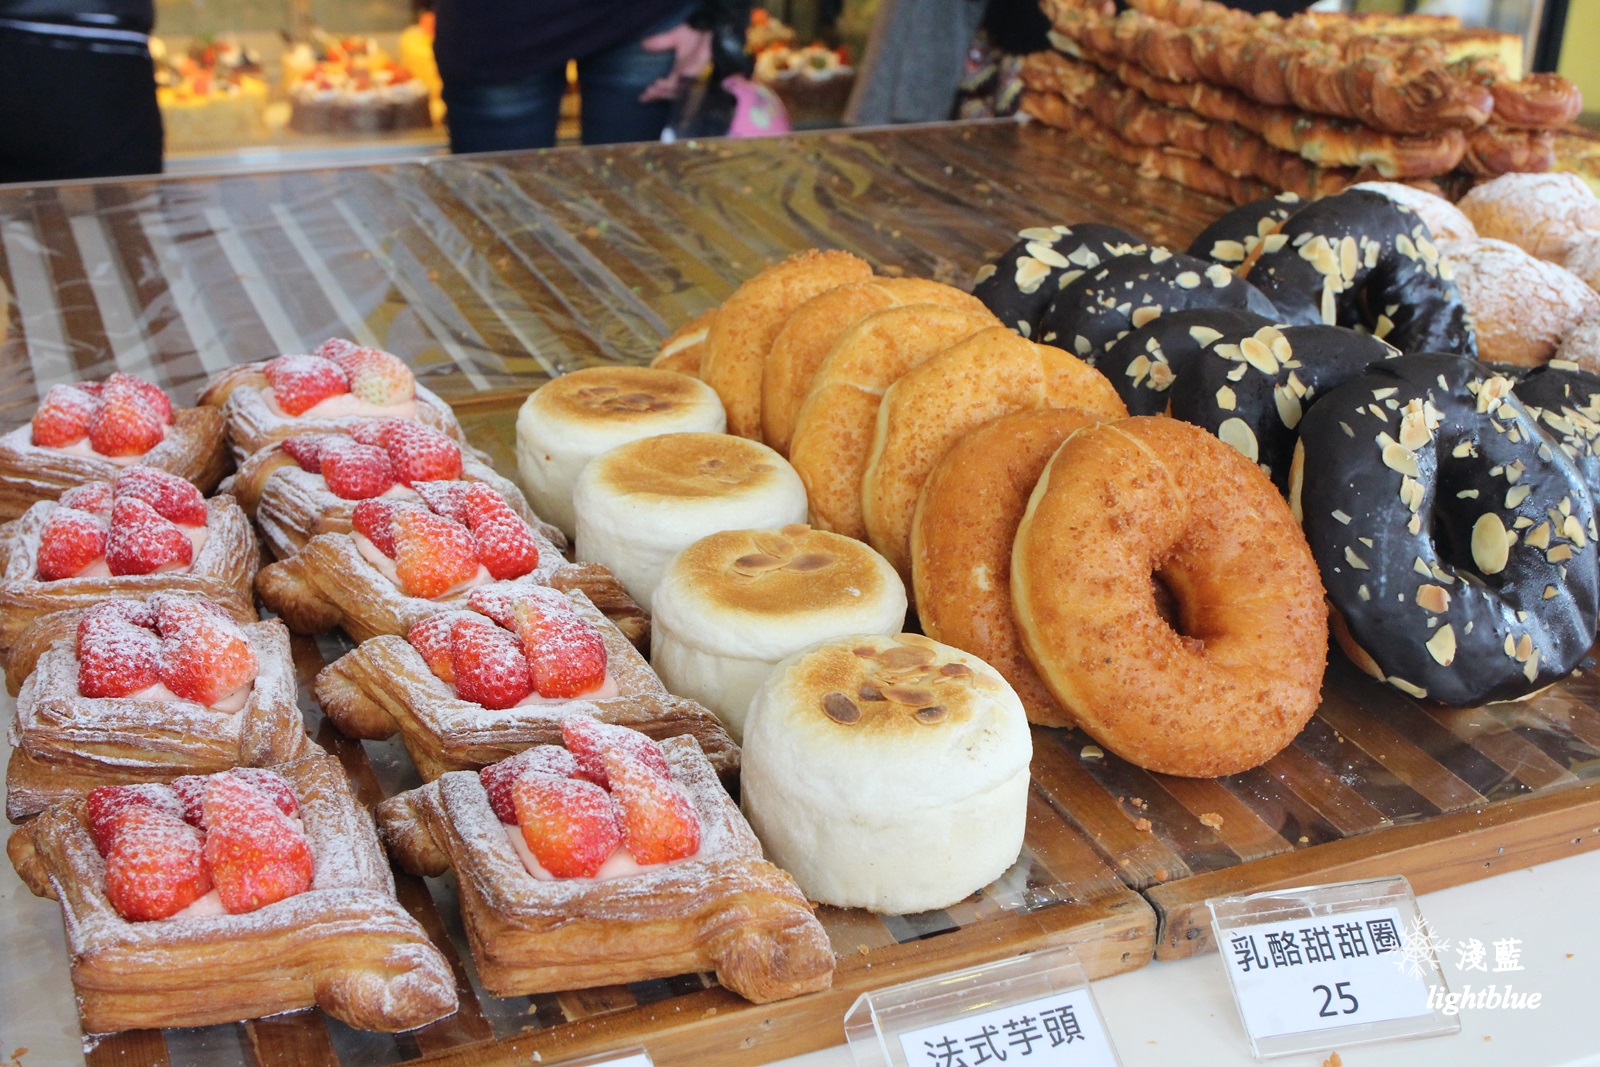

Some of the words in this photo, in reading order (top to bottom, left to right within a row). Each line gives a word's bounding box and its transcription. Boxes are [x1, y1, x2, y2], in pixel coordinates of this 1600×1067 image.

[1231, 918, 1401, 972] 乳酪甜甜圈
[1312, 981, 1359, 1017] 25
[923, 1004, 1085, 1067] 法式芋頭
